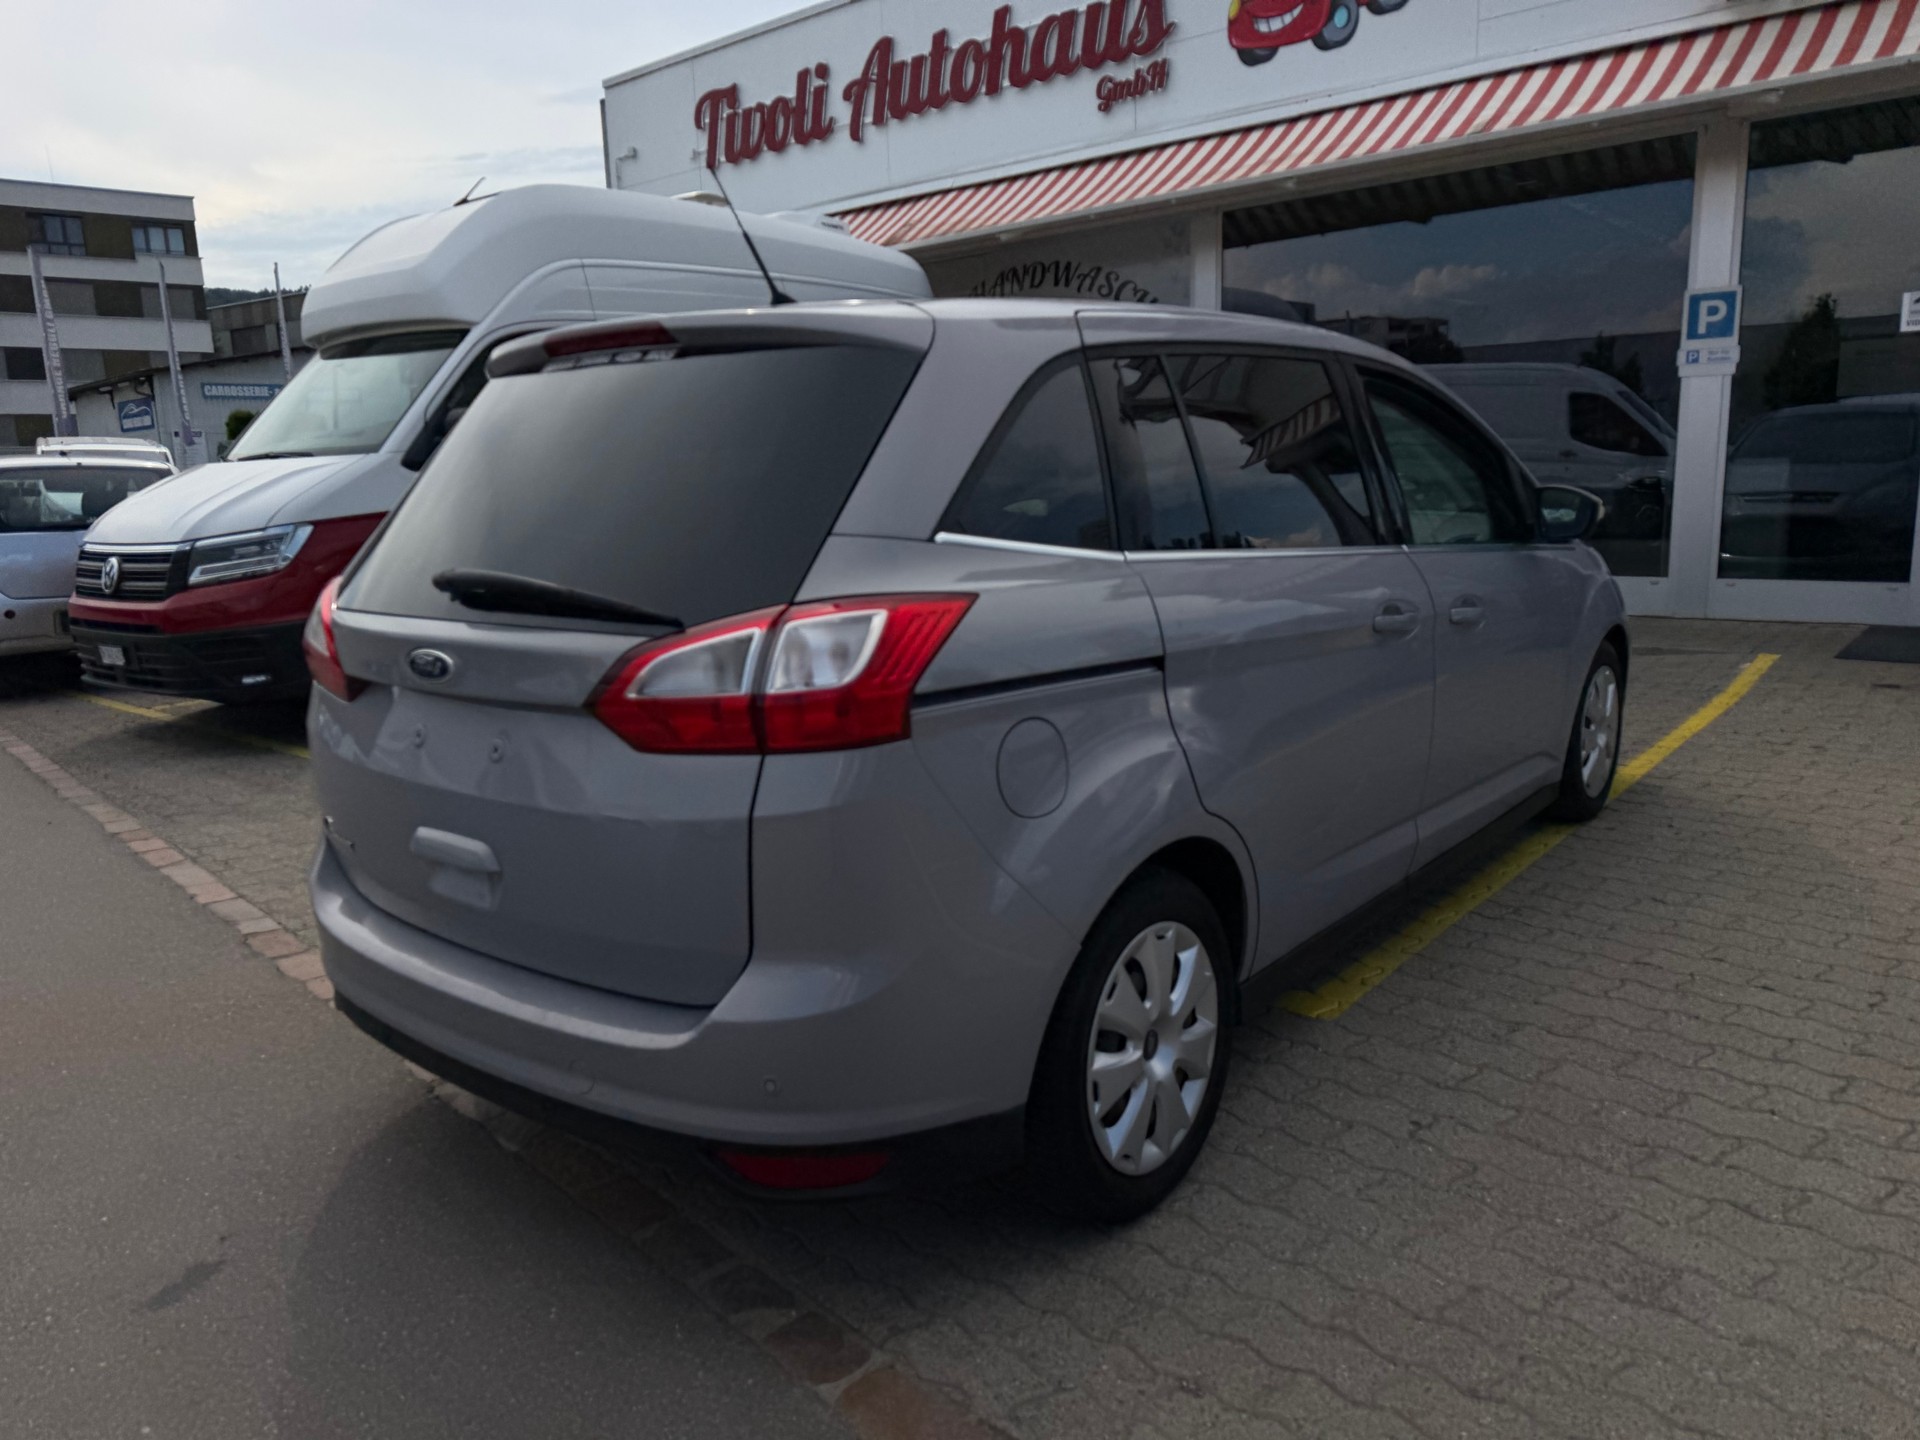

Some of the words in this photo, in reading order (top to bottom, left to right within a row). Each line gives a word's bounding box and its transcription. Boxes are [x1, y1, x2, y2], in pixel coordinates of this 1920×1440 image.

[694, 62, 835, 170] Tivoli
[842, 0, 1176, 143] Autohaus
[1097, 57, 1169, 113] GmbH
[1697, 299, 1728, 335] P
